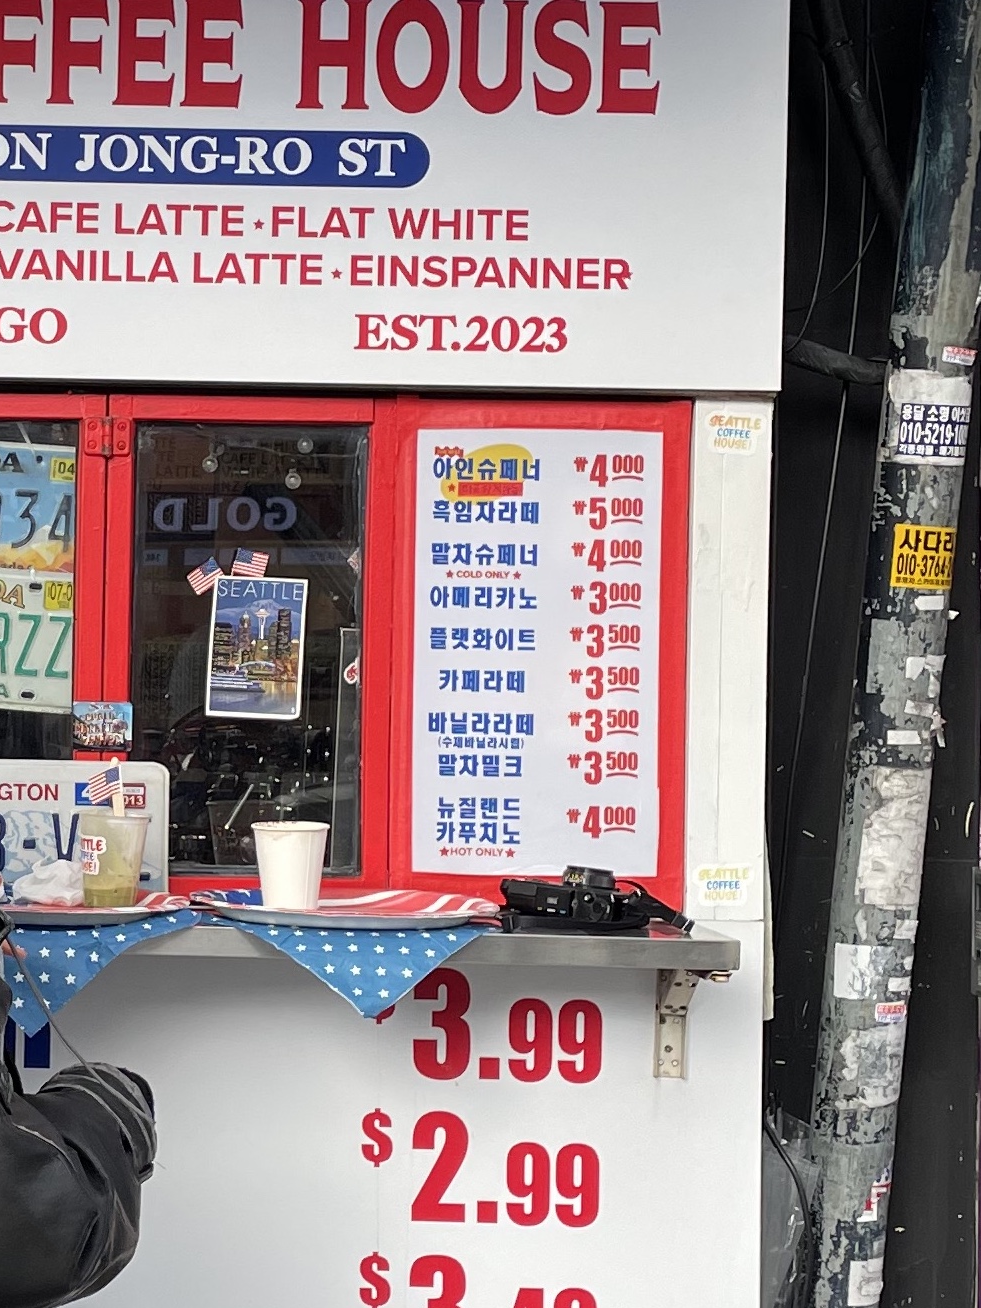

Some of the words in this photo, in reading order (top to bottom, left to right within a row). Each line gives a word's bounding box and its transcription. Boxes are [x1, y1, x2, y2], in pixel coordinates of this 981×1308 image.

[296, 0, 660, 115] HOUSE
[75, 134, 313, 176] JONG-RO
[338, 138, 406, 177] ST
[115, 204, 244, 236] LATTE
[272, 206, 374, 238] FLAT
[388, 208, 528, 241] WHITE
[194, 253, 322, 285] LATTE
[351, 255, 631, 289] EINSPANNER
[355, 314, 567, 353] EST.2023
[709, 414, 761, 430] SEATTLE
[717, 427, 751, 439] COFFEE
[713, 438, 752, 450] HOUSE!
[433, 458, 541, 481] 아인슈페너
[432, 500, 539, 524] 흑임자라떼
[431, 543, 538, 566] 말차슈페너
[456, 570, 483, 579] COLD
[485, 570, 510, 580] ONLY
[217, 580, 304, 600] SEATTLE
[429, 586, 538, 609] 아메리카노
[429, 627, 536, 651] 플랫화이트
[439, 670, 525, 693] 카페라떼
[428, 712, 534, 735] 바닐라라떼
[438, 754, 522, 778] 말차밀크
[437, 797, 520, 820] 뉴질랜드
[436, 822, 521, 845] 카푸치노
[450, 847, 473, 857] HOT
[476, 848, 504, 858] ONLY
[698, 868, 749, 881] SEATTLE
[706, 880, 740, 890] COFFEE
